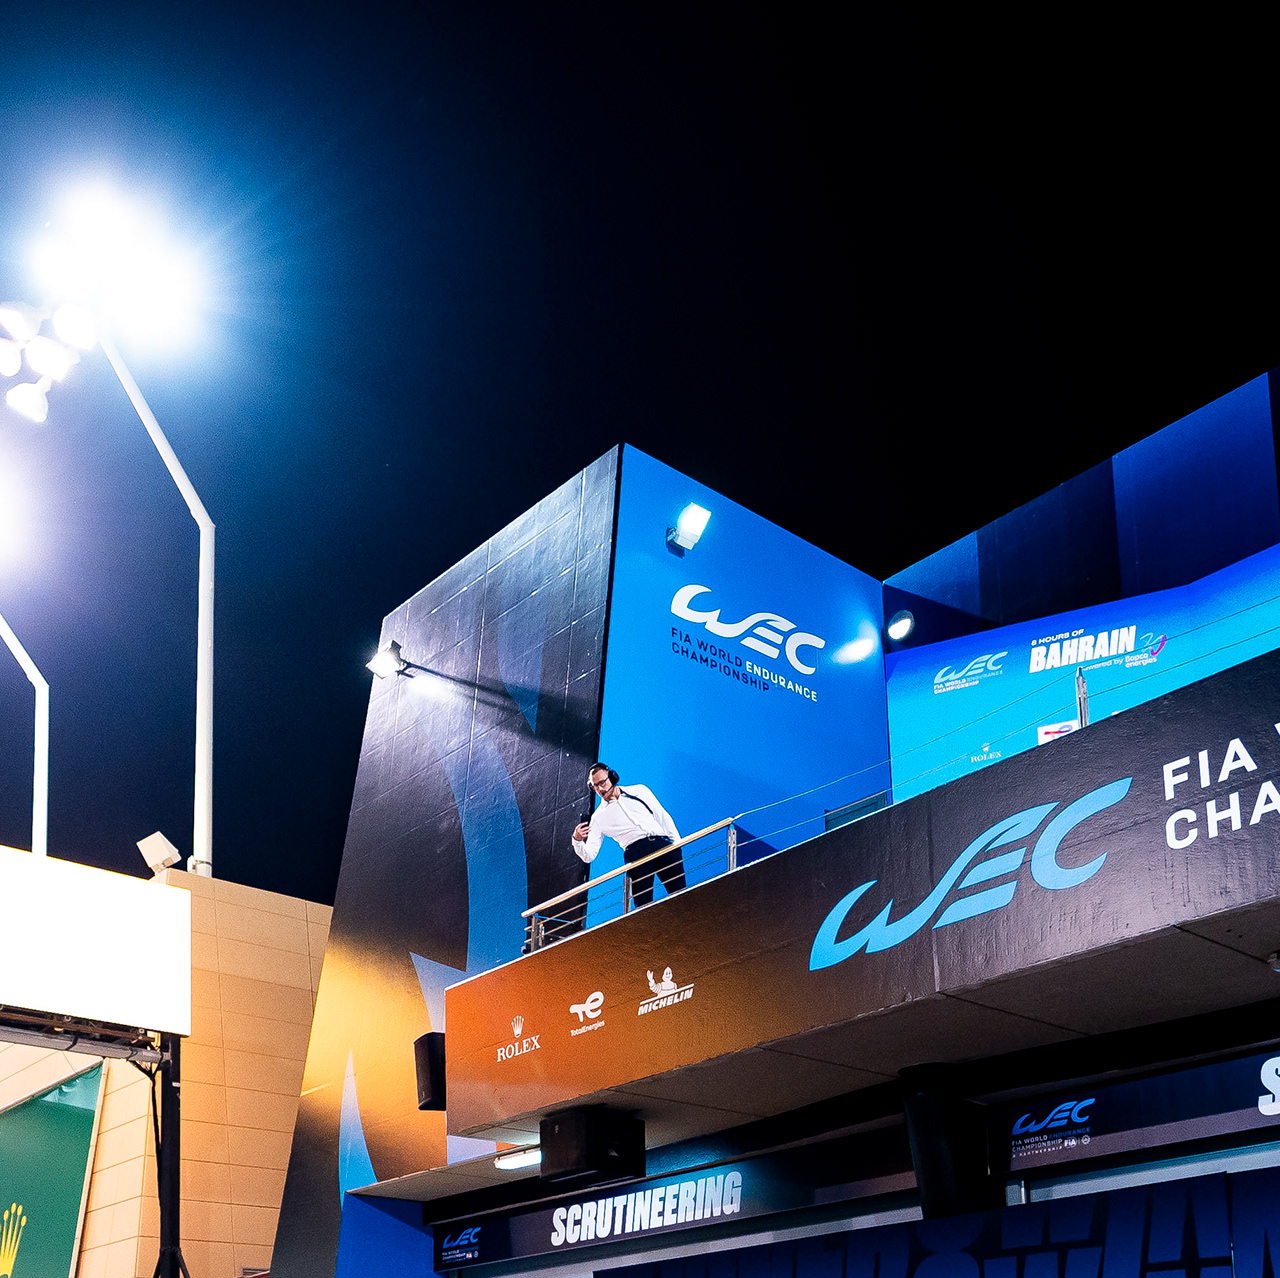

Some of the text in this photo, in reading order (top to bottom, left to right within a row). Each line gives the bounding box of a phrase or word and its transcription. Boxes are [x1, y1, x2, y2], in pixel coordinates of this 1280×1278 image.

[670, 584, 826, 676] WEC
[1038, 632, 1070, 645] HOURS
[1071, 628, 1085, 638] OF
[671, 626, 818, 703] FIA WORLD ENDURANCE
[1029, 625, 1136, 674] BAHRAIN
[672, 641, 770, 692] CHAMPIONSHIP
[933, 651, 1008, 684] WEC
[970, 750, 1003, 764] ROLEX
[1163, 737, 1258, 803] FIA
[809, 776, 1133, 971] WEC
[637, 988, 694, 1016] MICHELIN
[570, 1019, 606, 1037] TotalEnergies
[496, 1034, 541, 1063] ROLEX
[1011, 1097, 1096, 1136] WEC
[1011, 1139, 1063, 1152] CHAMPIONSHIP
[1024, 1135, 1048, 1144] WORLD
[1049, 1127, 1091, 1139] ENDURANCE
[551, 1171, 743, 1247] SCRUTINEERING
[442, 1226, 482, 1249] WEC
